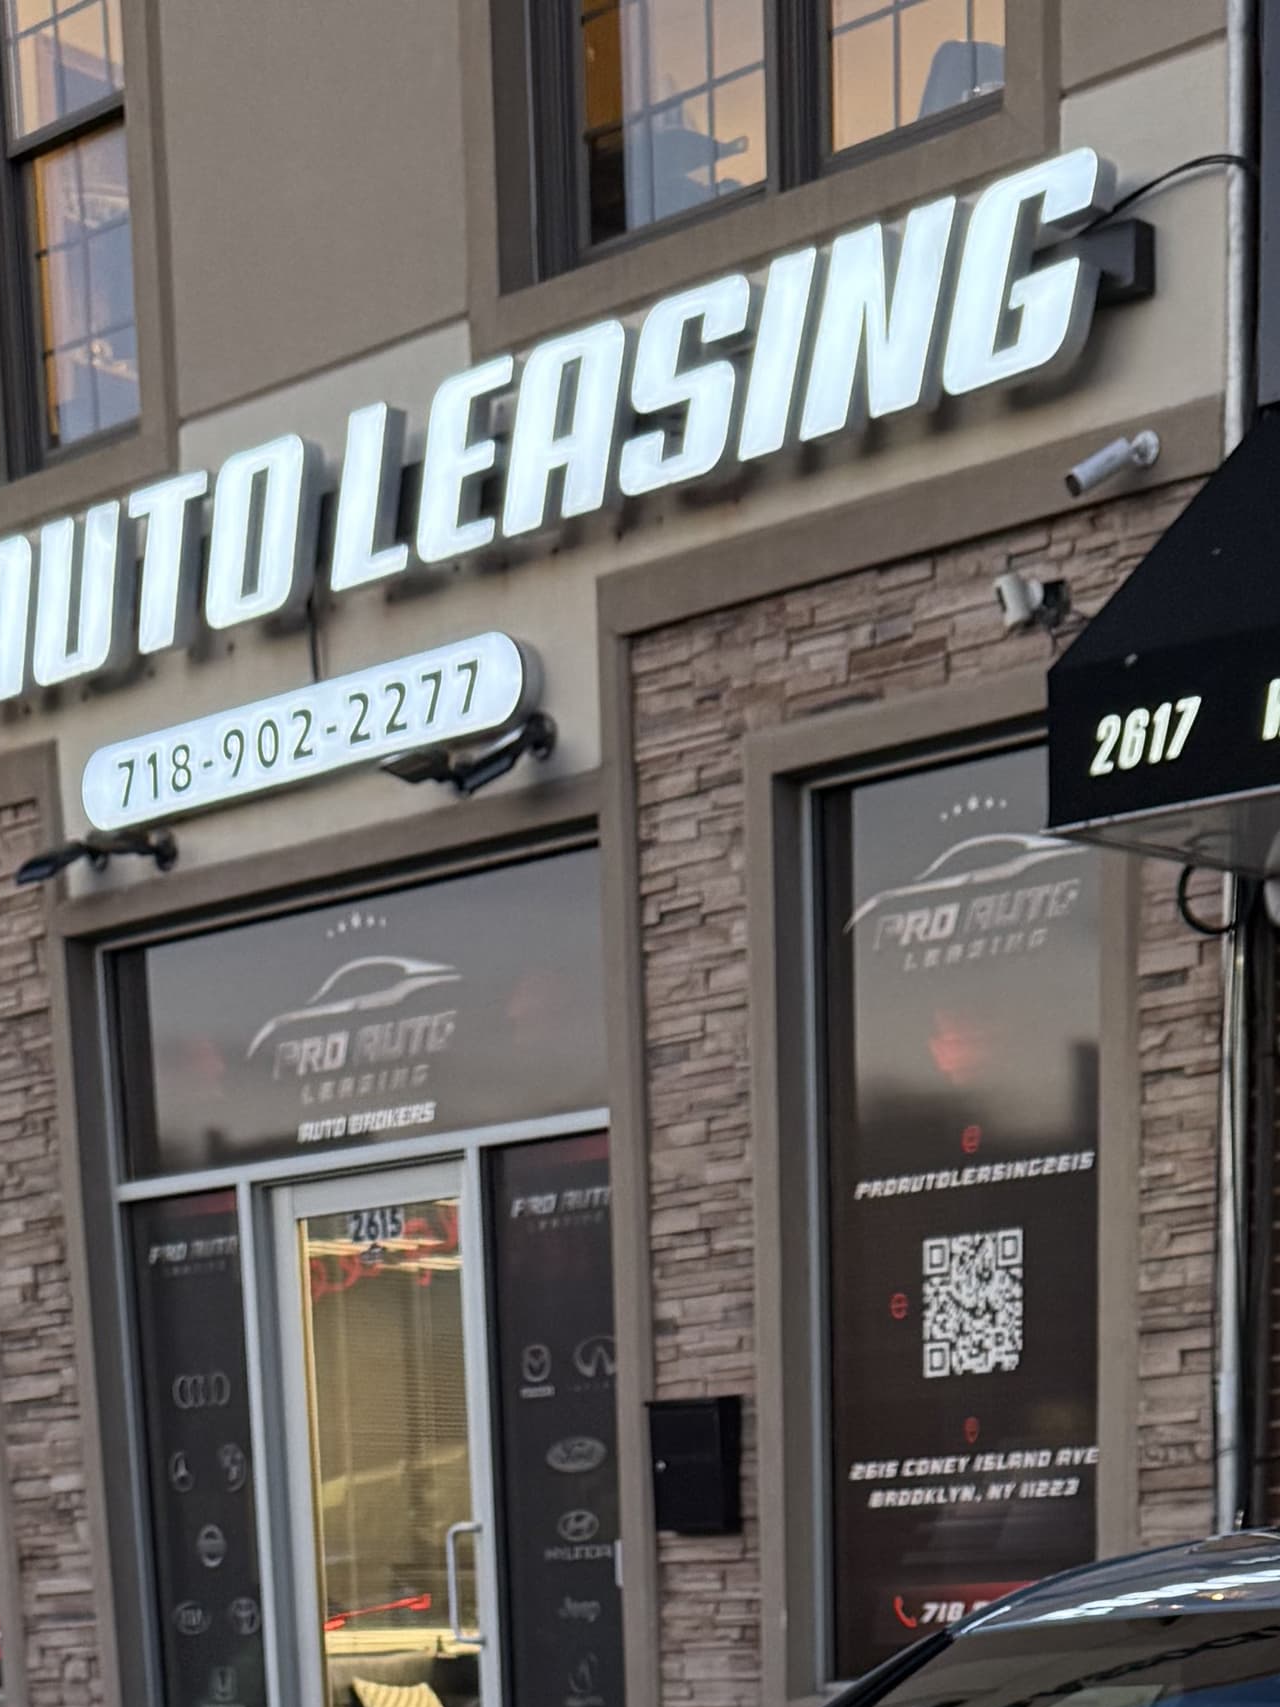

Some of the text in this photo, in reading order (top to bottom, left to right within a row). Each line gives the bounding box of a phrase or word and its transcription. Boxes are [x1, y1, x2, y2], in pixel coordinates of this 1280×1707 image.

[330, 147, 1102, 592] LEASING
[118, 659, 478, 807] 718-902-2277
[1089, 695, 1202, 776] 2617
[873, 903, 960, 951] PRO
[904, 928, 1048, 972] LEASING
[273, 1031, 350, 1080] PRO
[300, 1063, 430, 1105] LEASING
[297, 1101, 437, 1145] AUTO BROKERS
[351, 1208, 404, 1242] 2615
[849, 1460, 899, 1480] 2615
[900, 1456, 971, 1478] CONEY
[972, 1450, 1053, 1473] ISLAND
[868, 1477, 1081, 1508] BROOKLYN, NY 11223
